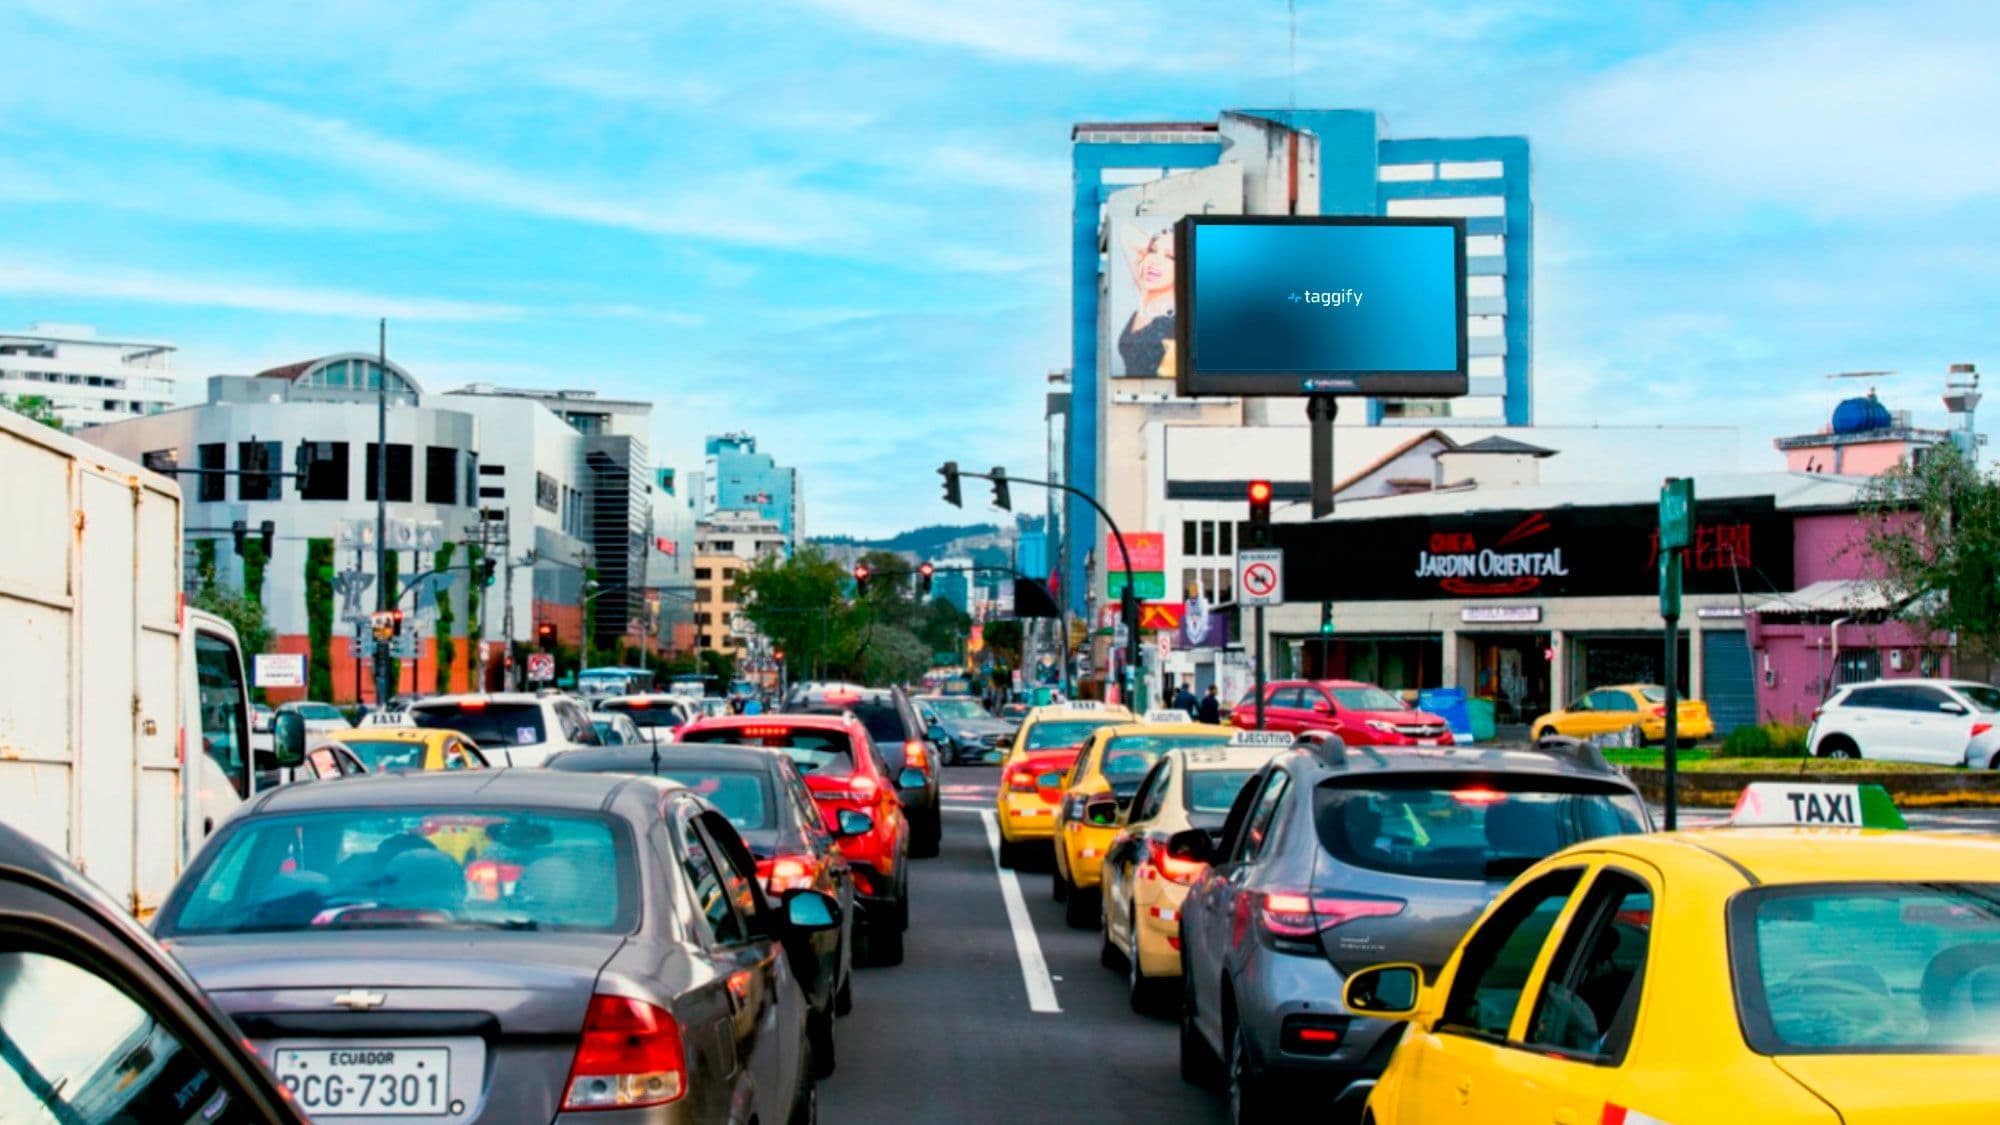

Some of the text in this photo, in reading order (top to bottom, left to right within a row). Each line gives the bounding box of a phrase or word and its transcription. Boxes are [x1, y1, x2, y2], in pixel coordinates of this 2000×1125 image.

[1304, 288, 1363, 307] taggify
[1415, 548, 1569, 578] JARDIN ORIENTAL
[1237, 733, 1292, 744] EJECUTIVO
[1787, 792, 1854, 824] TAXI
[329, 1052, 394, 1066] ECUADOR
